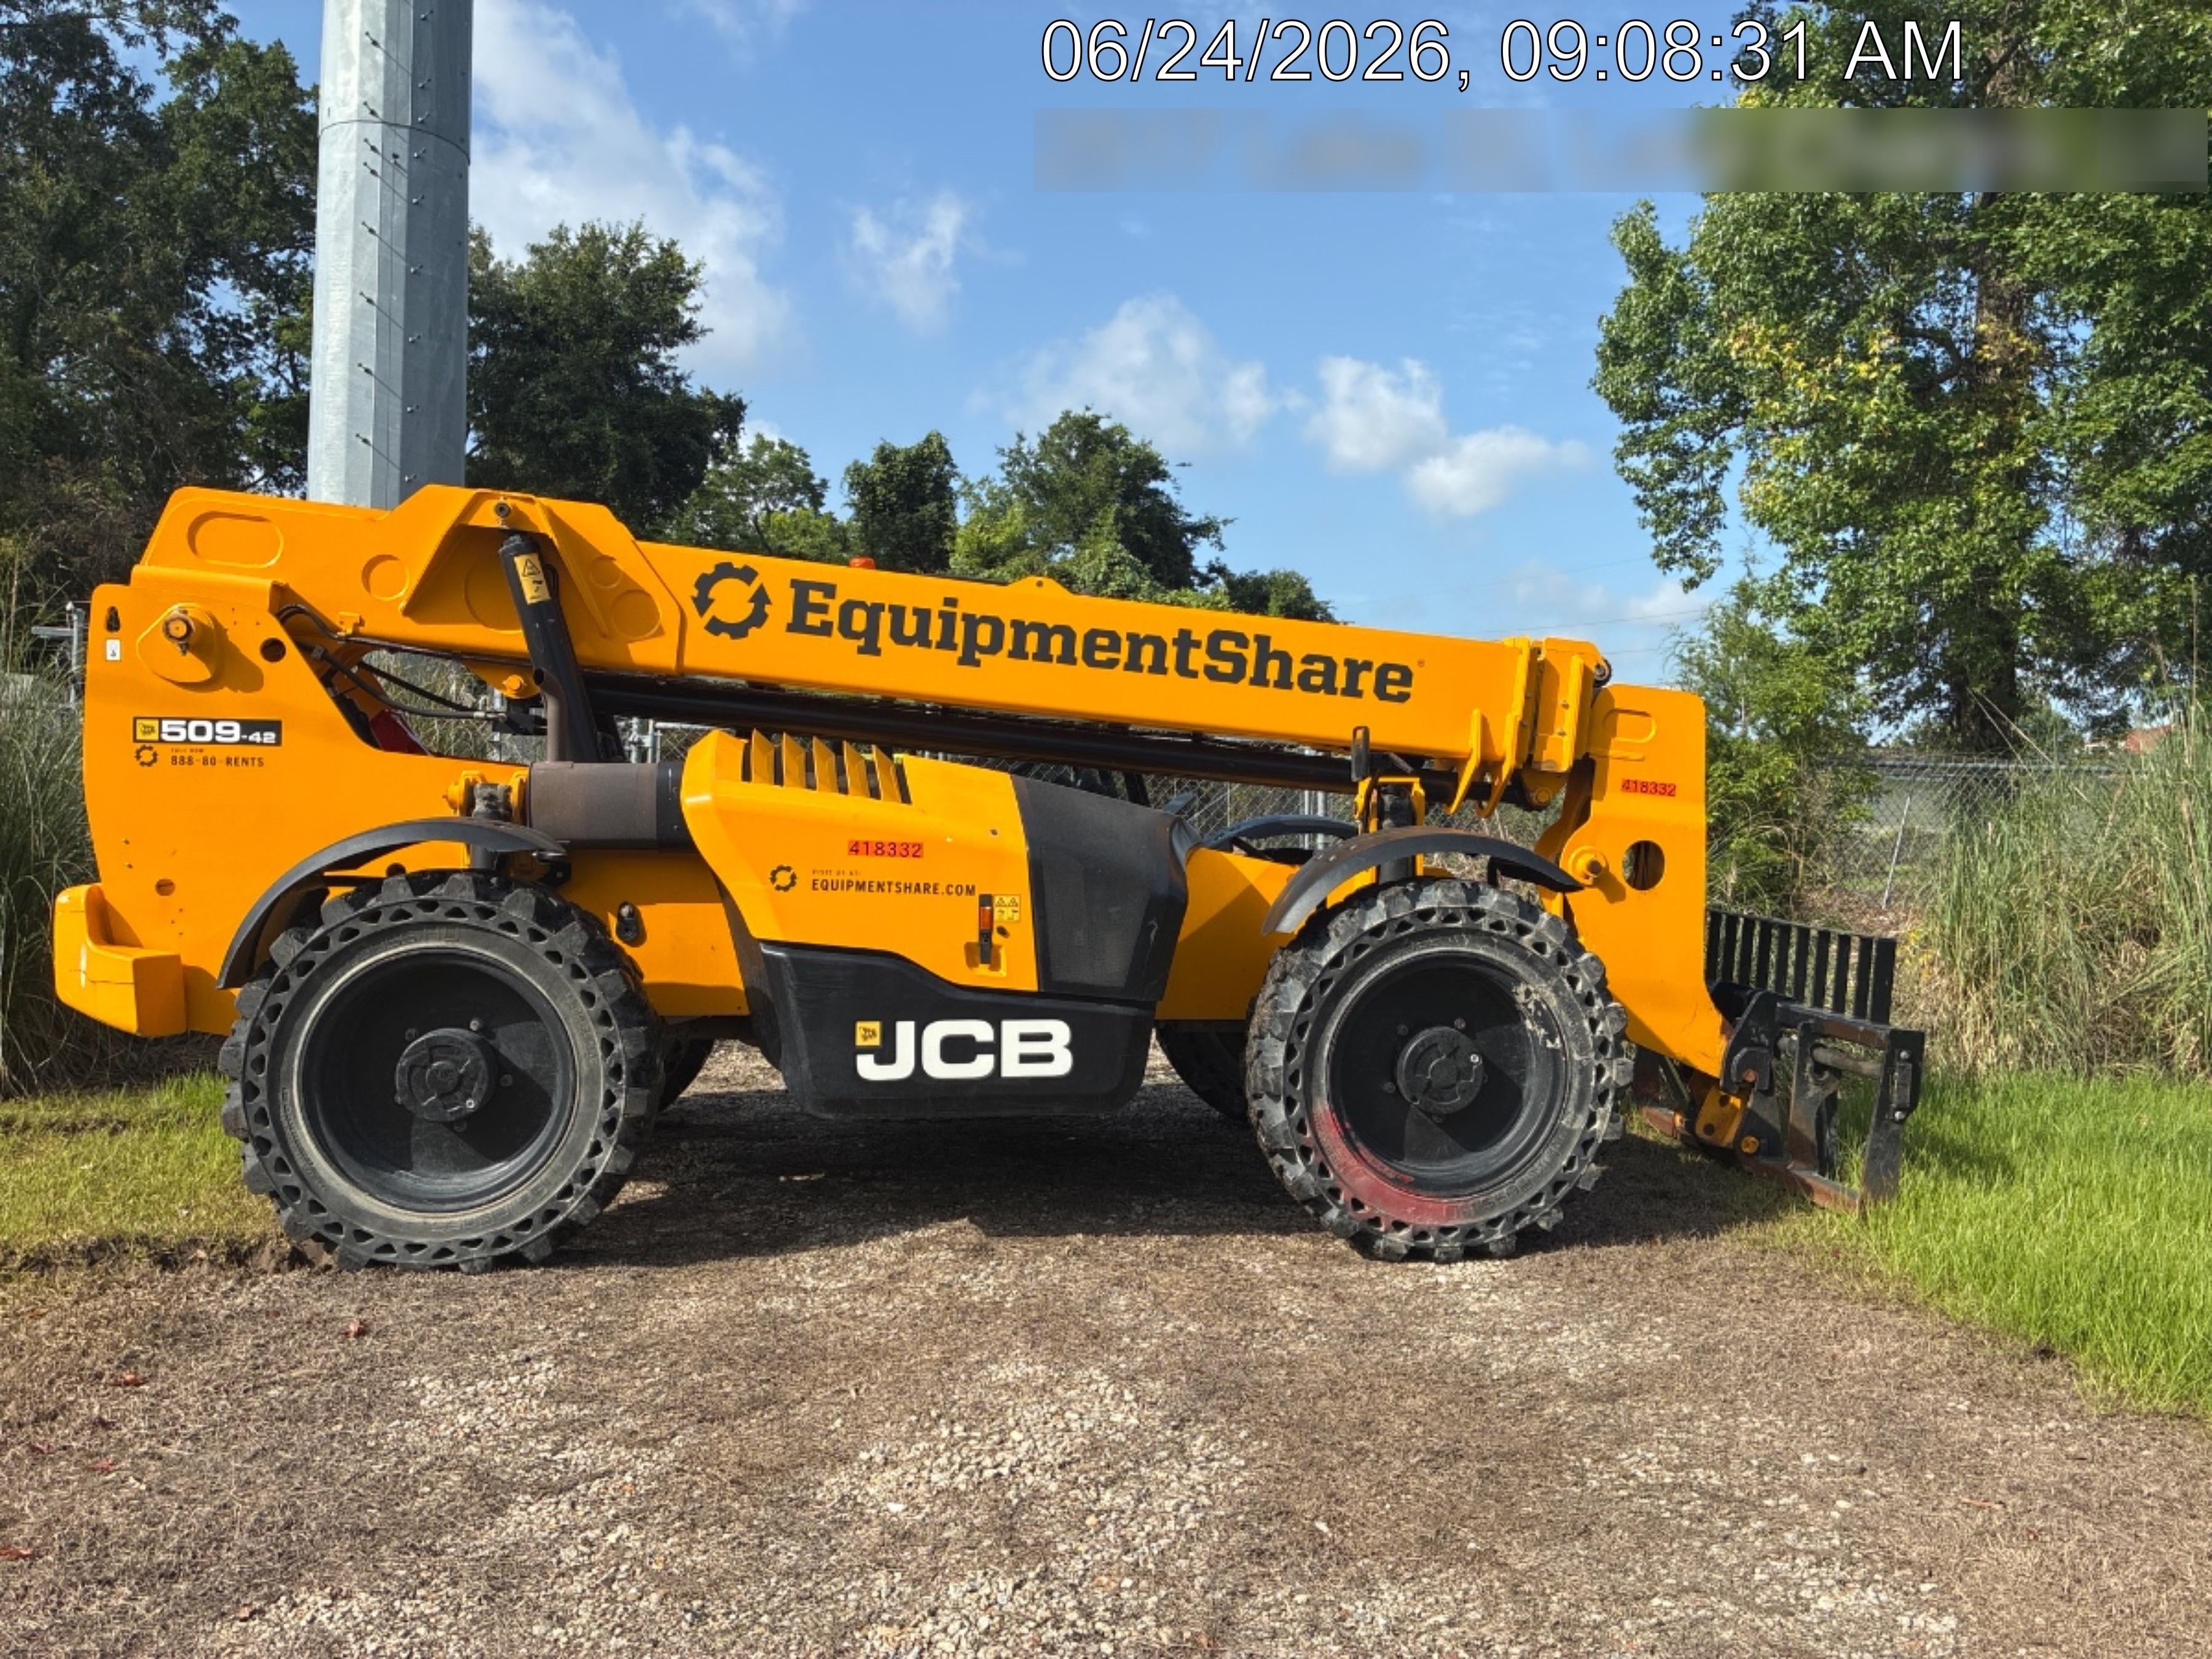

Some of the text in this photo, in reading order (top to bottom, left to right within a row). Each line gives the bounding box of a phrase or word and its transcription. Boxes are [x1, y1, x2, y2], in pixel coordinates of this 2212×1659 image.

[786, 579, 1413, 704] EquipmentShare
[160, 719, 276, 743] 509-42
[1622, 779, 1676, 796] 418332
[849, 840, 922, 858] 418332
[812, 879, 976, 896] EQUIPMENTSHARE.COM
[855, 1019, 1073, 1081] JCB
